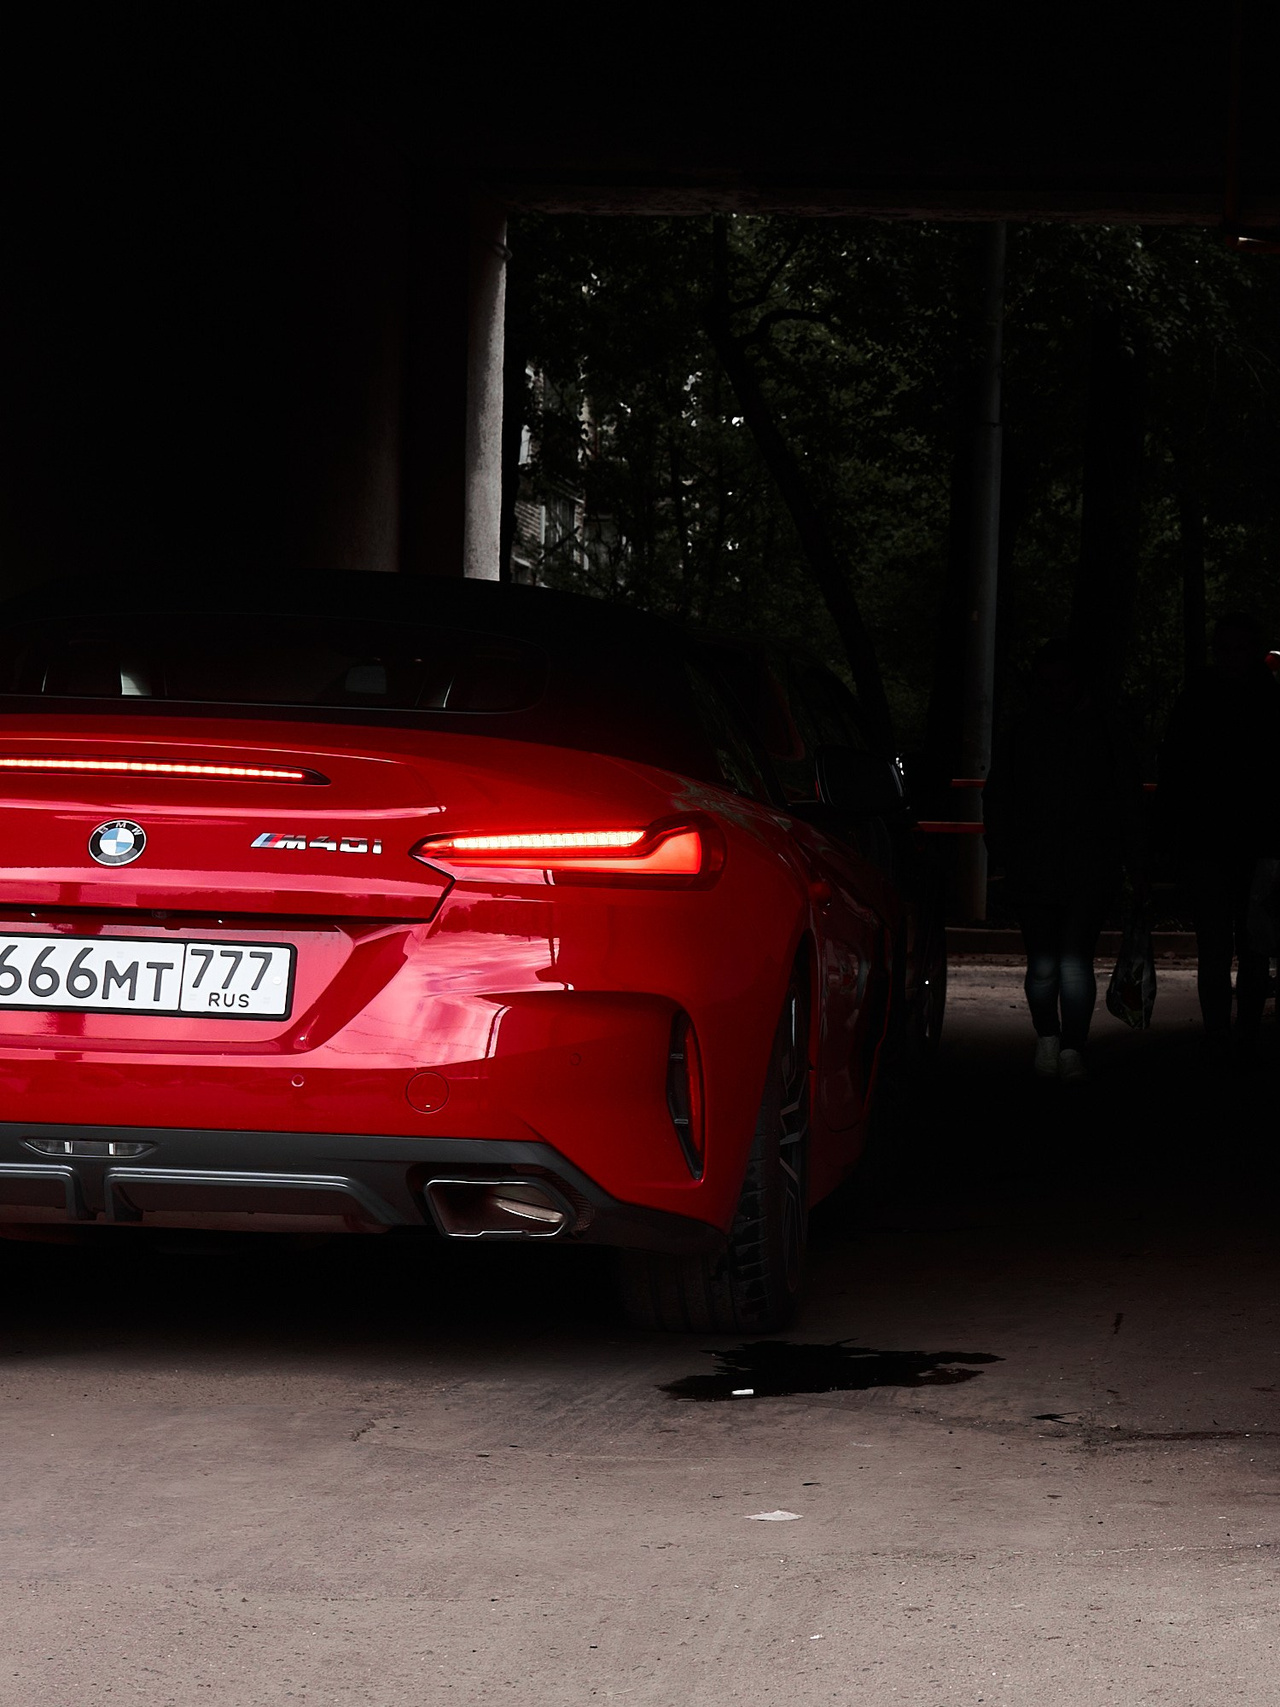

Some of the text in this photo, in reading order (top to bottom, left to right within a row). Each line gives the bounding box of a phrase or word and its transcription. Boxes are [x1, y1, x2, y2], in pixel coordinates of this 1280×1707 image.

[98, 820, 143, 837] BMW
[270, 832, 382, 855] M40i
[190, 948, 273, 991] 777
[208, 991, 251, 1008] RUS
